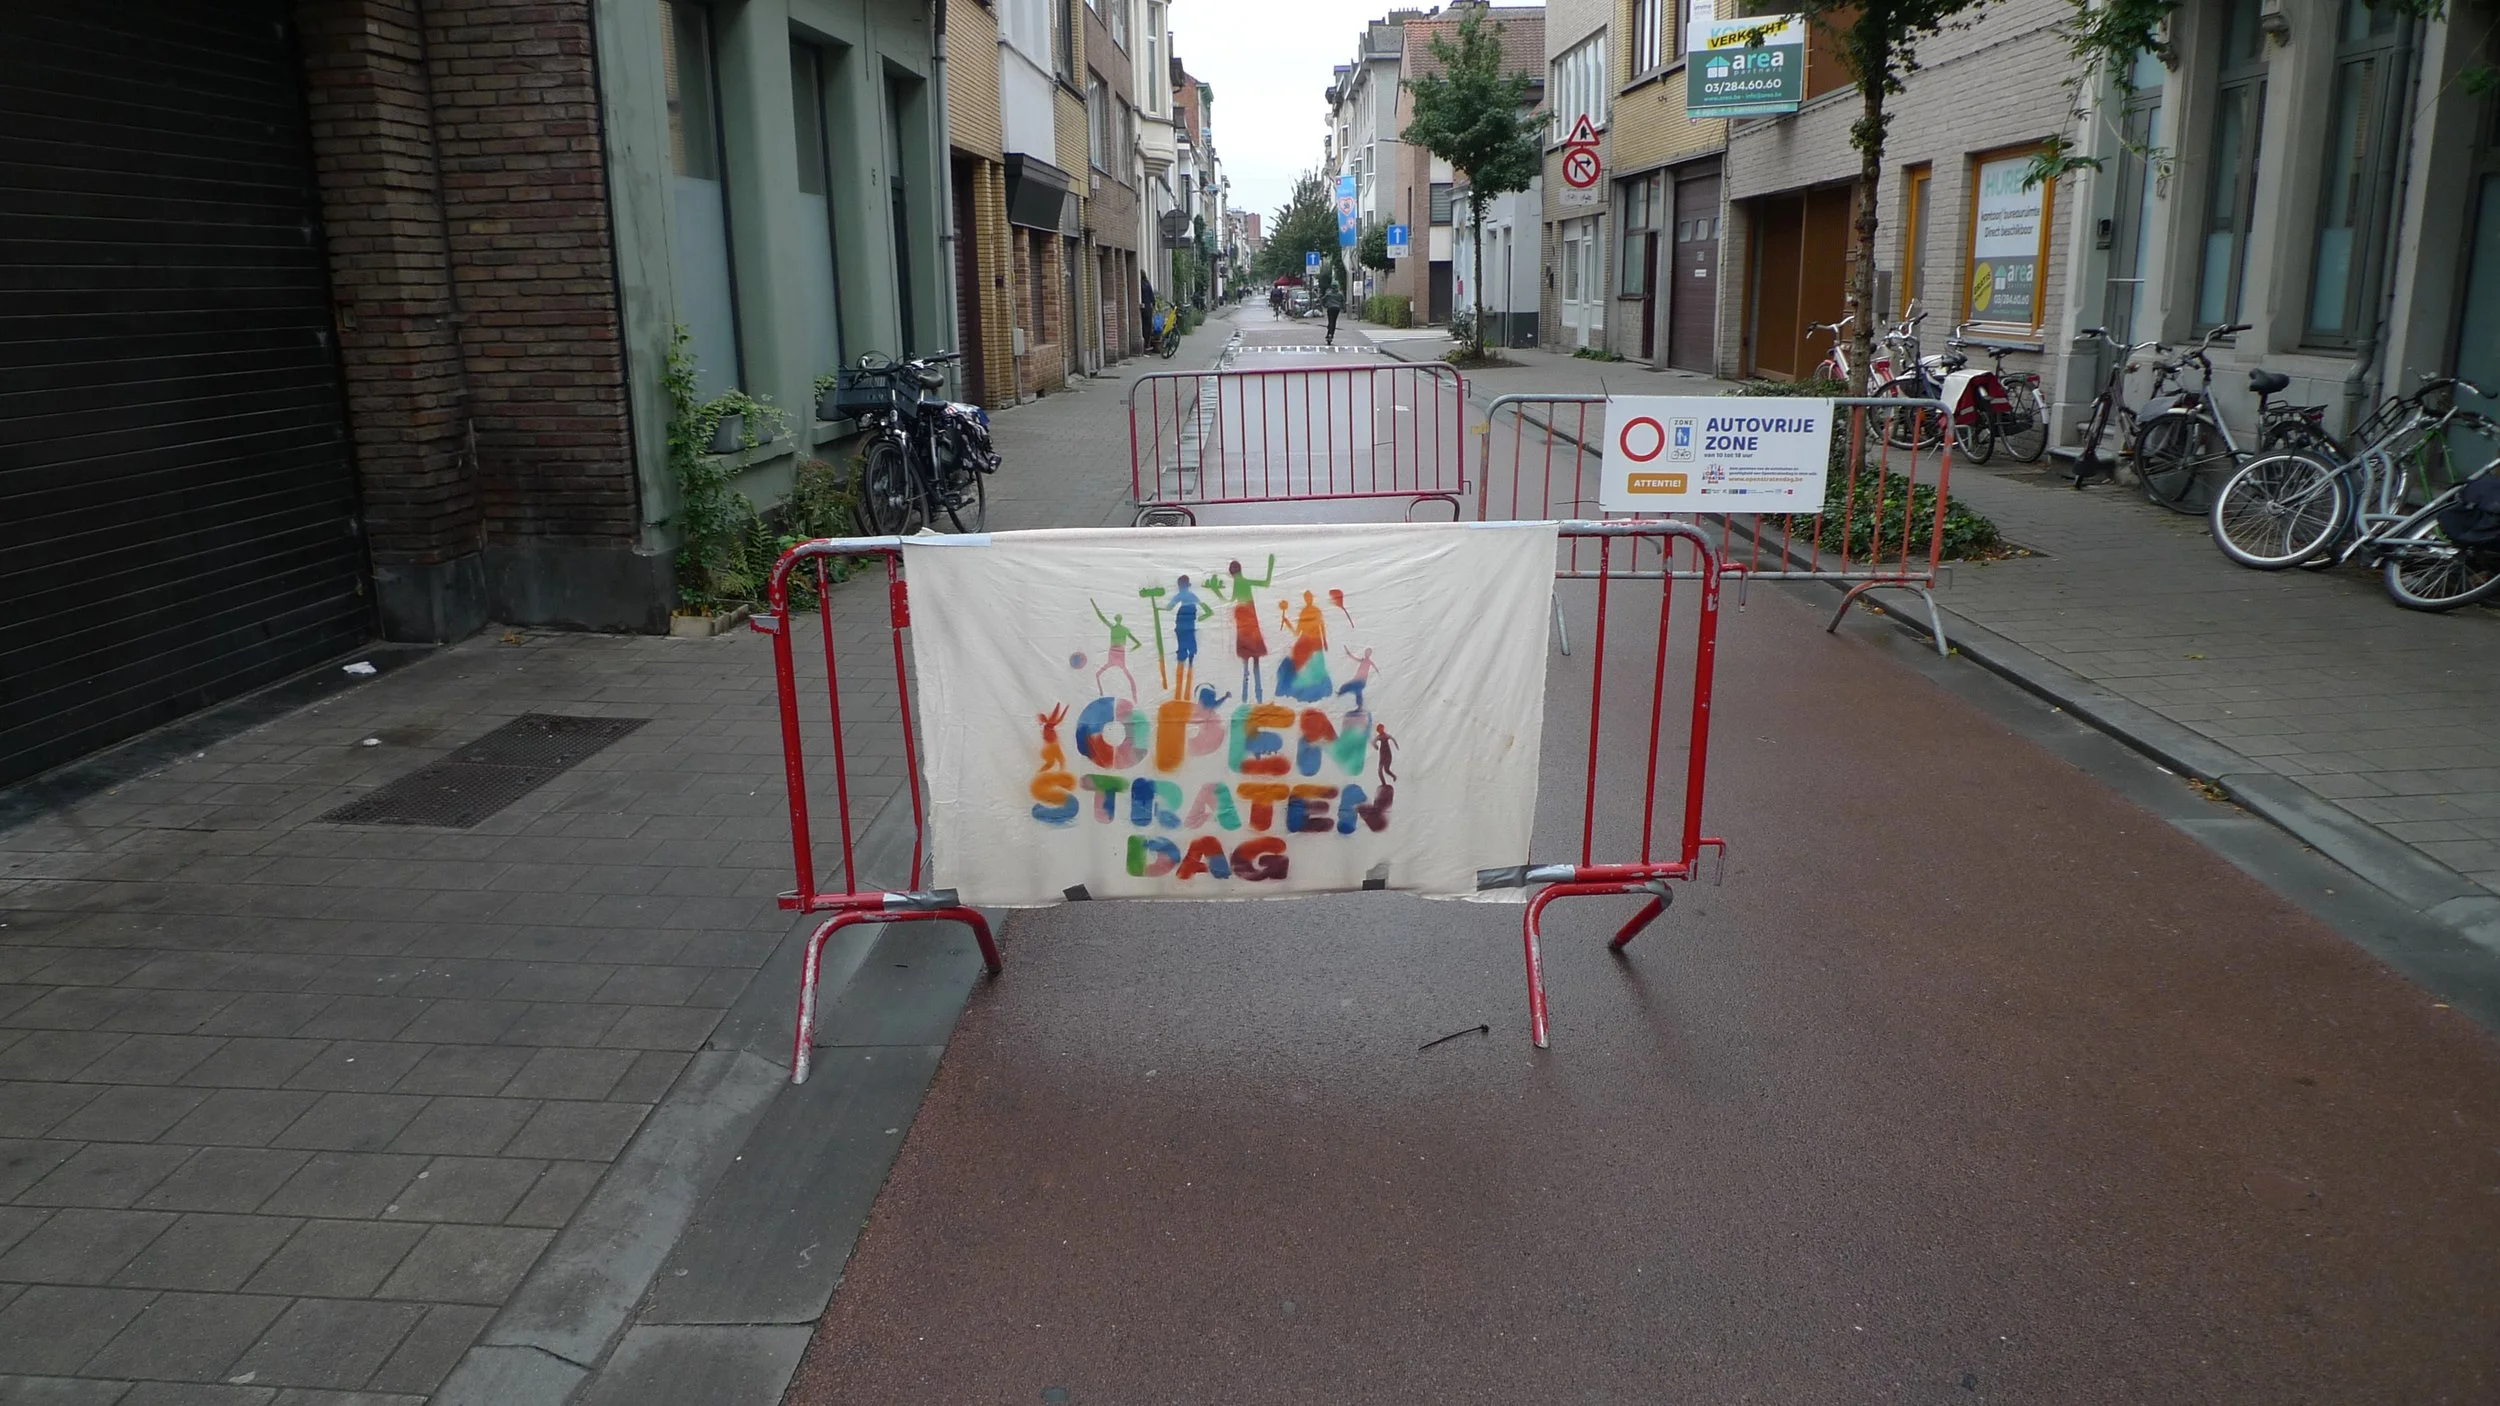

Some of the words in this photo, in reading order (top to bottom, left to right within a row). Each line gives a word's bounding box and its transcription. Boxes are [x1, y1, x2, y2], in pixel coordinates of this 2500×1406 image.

[1733, 51, 1784, 69] area
[1704, 79, 1782, 94] 03/284.60.60
[2007, 264, 2034, 282] area
[1706, 418, 1814, 433] AUTOVRIJE
[1705, 436, 1758, 450] ZONE
[1633, 479, 1682, 488] ATTENTIE!
[1075, 696, 1372, 777] OPEN
[1030, 771, 1394, 835] STRATEN
[1126, 834, 1290, 881] DAG
